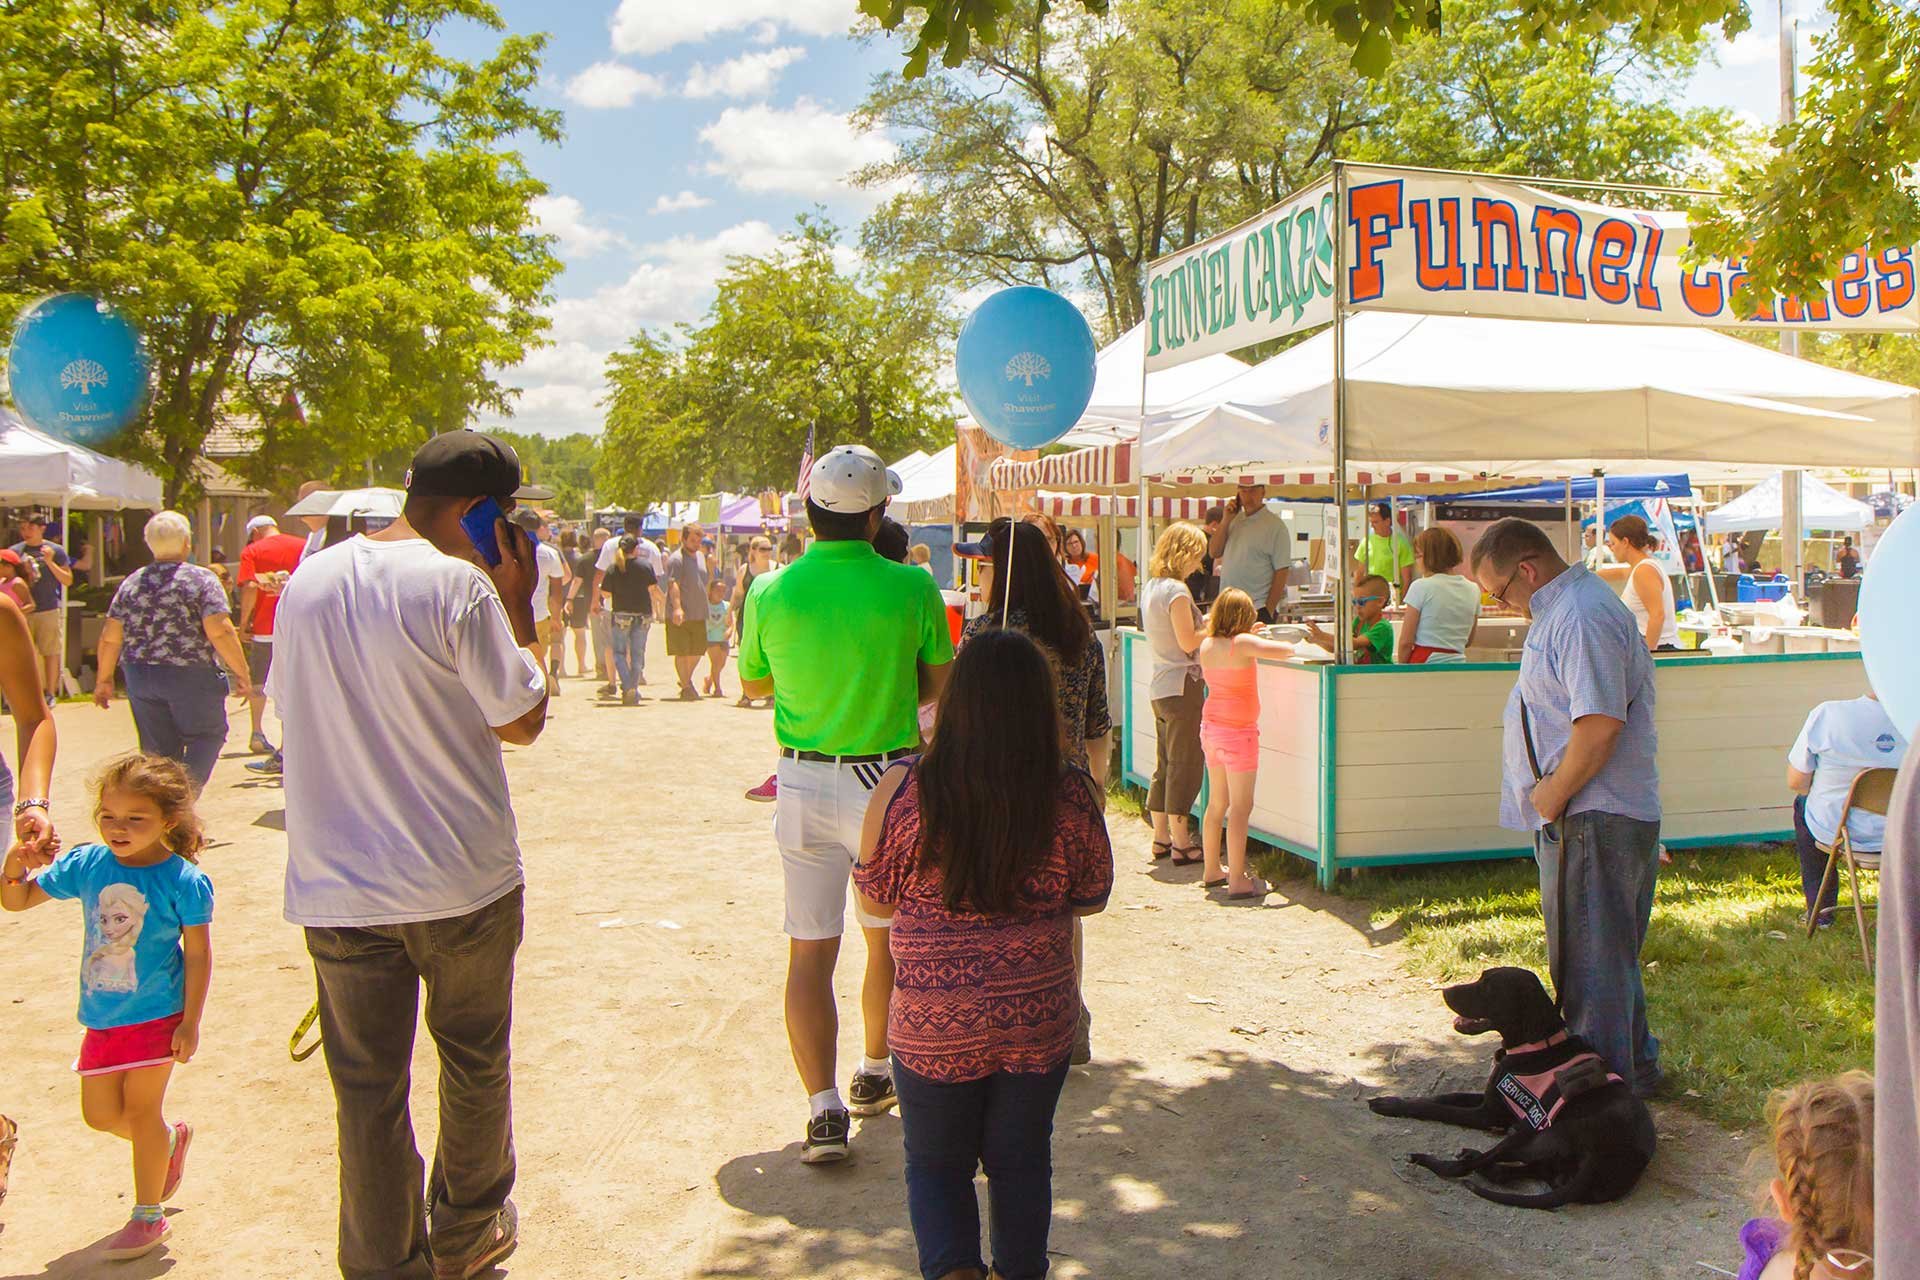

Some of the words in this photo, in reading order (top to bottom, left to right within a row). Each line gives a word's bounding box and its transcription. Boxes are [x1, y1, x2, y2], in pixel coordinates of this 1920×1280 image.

[1147, 240, 1237, 357] FUNNEL
[1243, 191, 1335, 326] CAKES
[1348, 178, 1664, 311] Funnel
[72, 401, 97, 411] Visit
[1500, 1078, 1532, 1108] SERVICE
